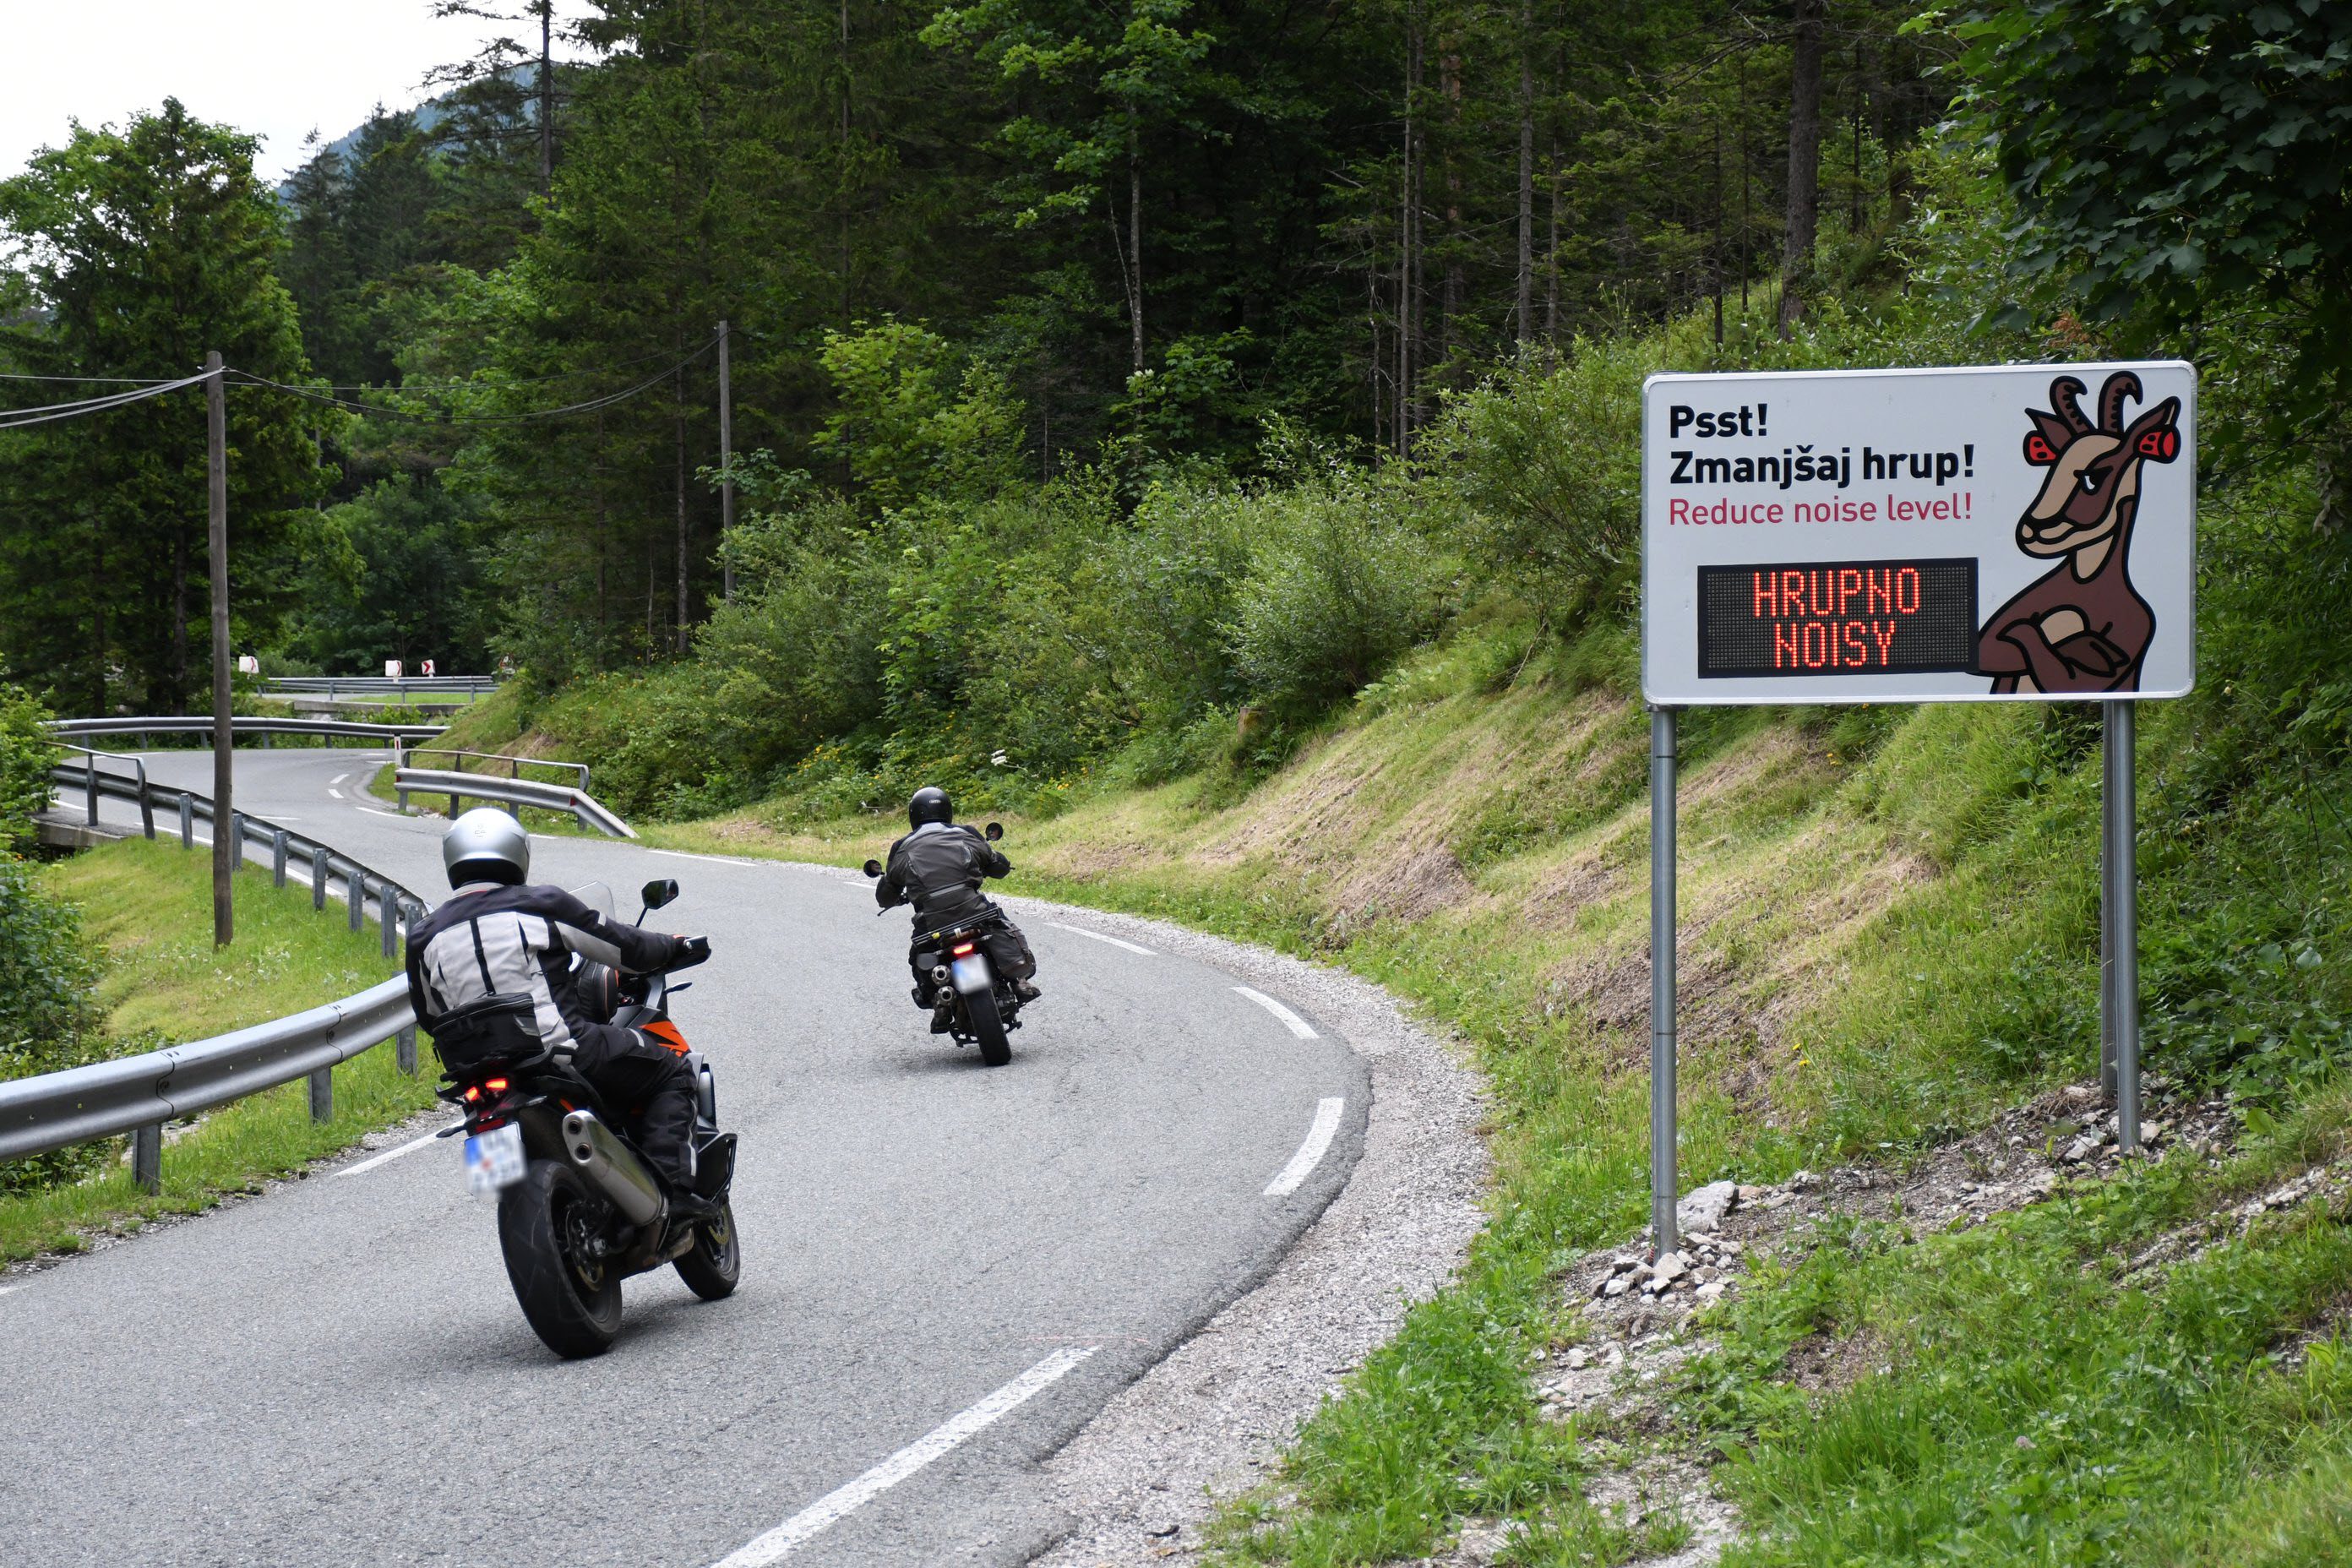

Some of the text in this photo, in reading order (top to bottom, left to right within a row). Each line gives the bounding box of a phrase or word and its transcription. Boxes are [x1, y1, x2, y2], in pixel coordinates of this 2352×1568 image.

[1669, 403, 1767, 438] Psst!
[1669, 444, 1974, 490] Zmanjšaj hrup!
[1669, 492, 1971, 525] Reduce noise level!
[1752, 567, 1921, 618] HRUPNO
[1773, 619, 1897, 668] NOISY
